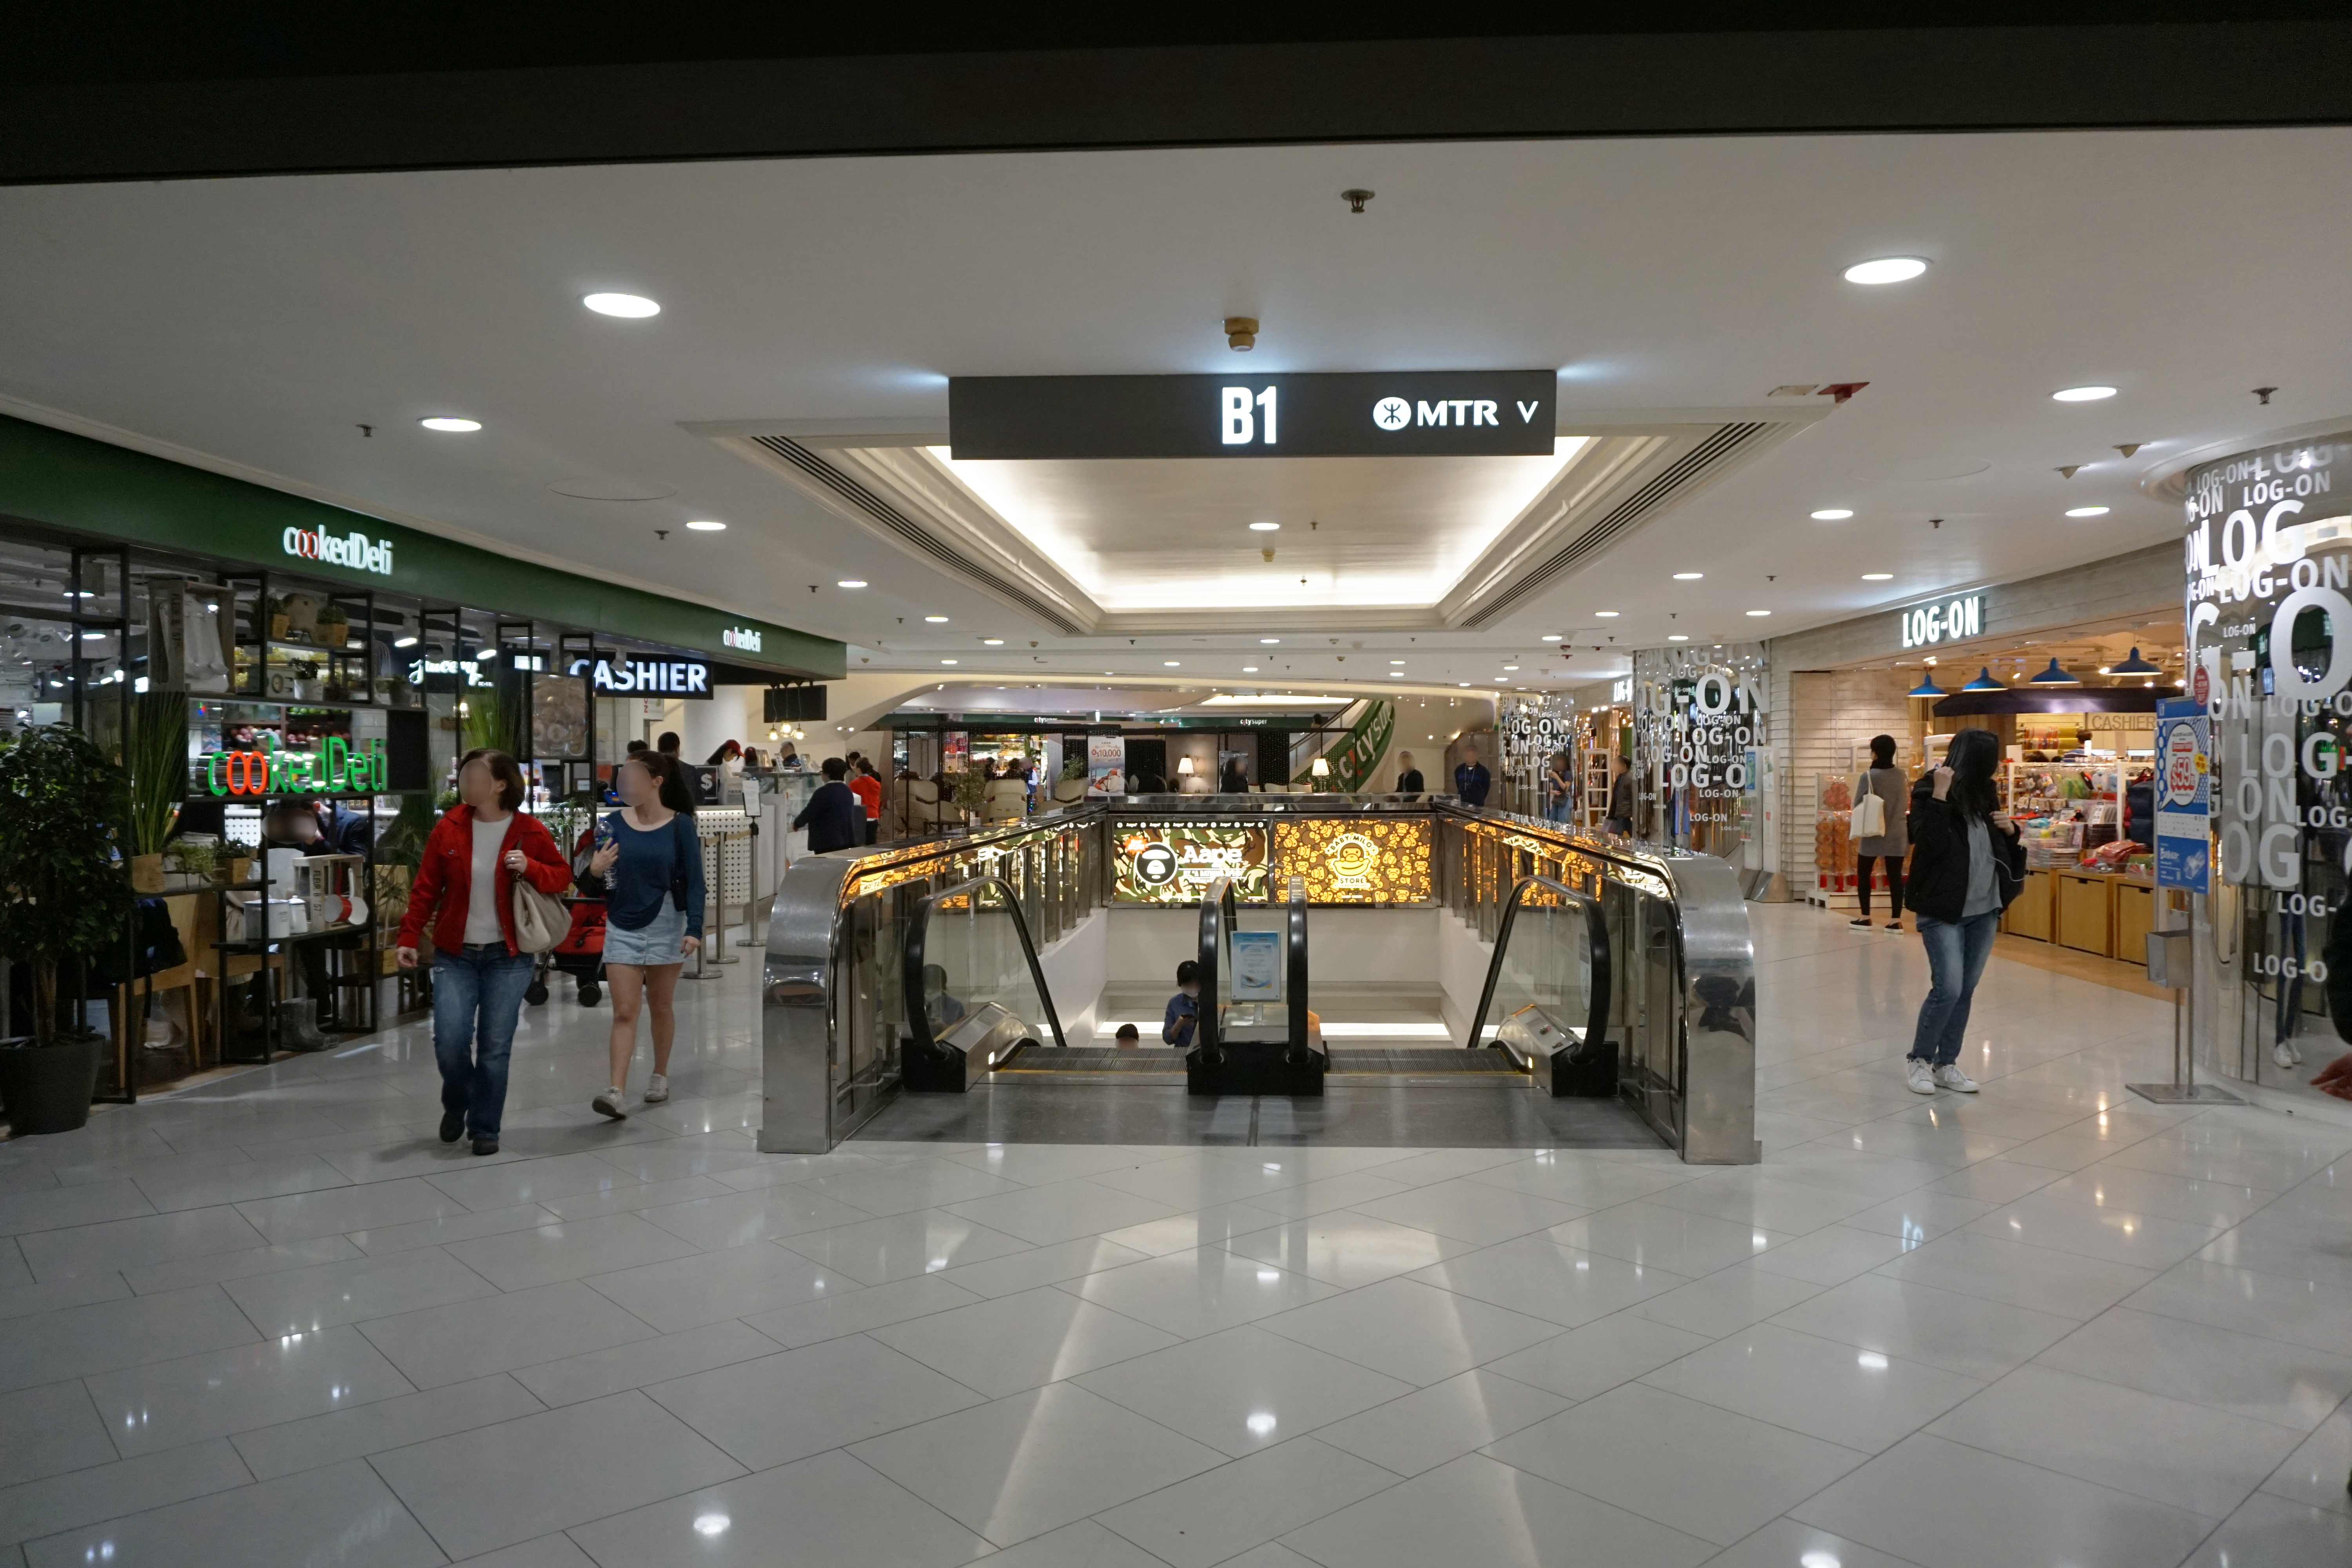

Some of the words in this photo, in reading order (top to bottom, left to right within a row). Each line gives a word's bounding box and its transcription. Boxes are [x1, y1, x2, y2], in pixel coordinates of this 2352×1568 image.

[1221, 386, 1276, 445] B1
[1417, 400, 1499, 426] MTR
[2197, 460, 2249, 494] LOG-ON
[2243, 470, 2330, 507] LOG-ON
[283, 524, 392, 575] cookedDeli
[2219, 554, 2348, 604] LOG-ON
[1903, 596, 1979, 648] LOG-ON
[2223, 623, 2256, 638] LOG-ON
[723, 626, 762, 652] cookedDeli
[1506, 719, 1564, 735] LOG-ON
[1696, 715, 1741, 726] LOG-ON
[2092, 715, 2156, 730] CASHIER
[1682, 726, 1767, 746] LOG-ON
[208, 735, 387, 796] cookedDeli
[1639, 792, 1657, 800] LOG-ON
[1699, 789, 1739, 798] LOG-ON
[1690, 813, 1728, 822] LOG-ON
[1330, 835, 1349, 850] BABY
[1353, 835, 1372, 847] MILO
[1181, 845, 1243, 868] Aape
